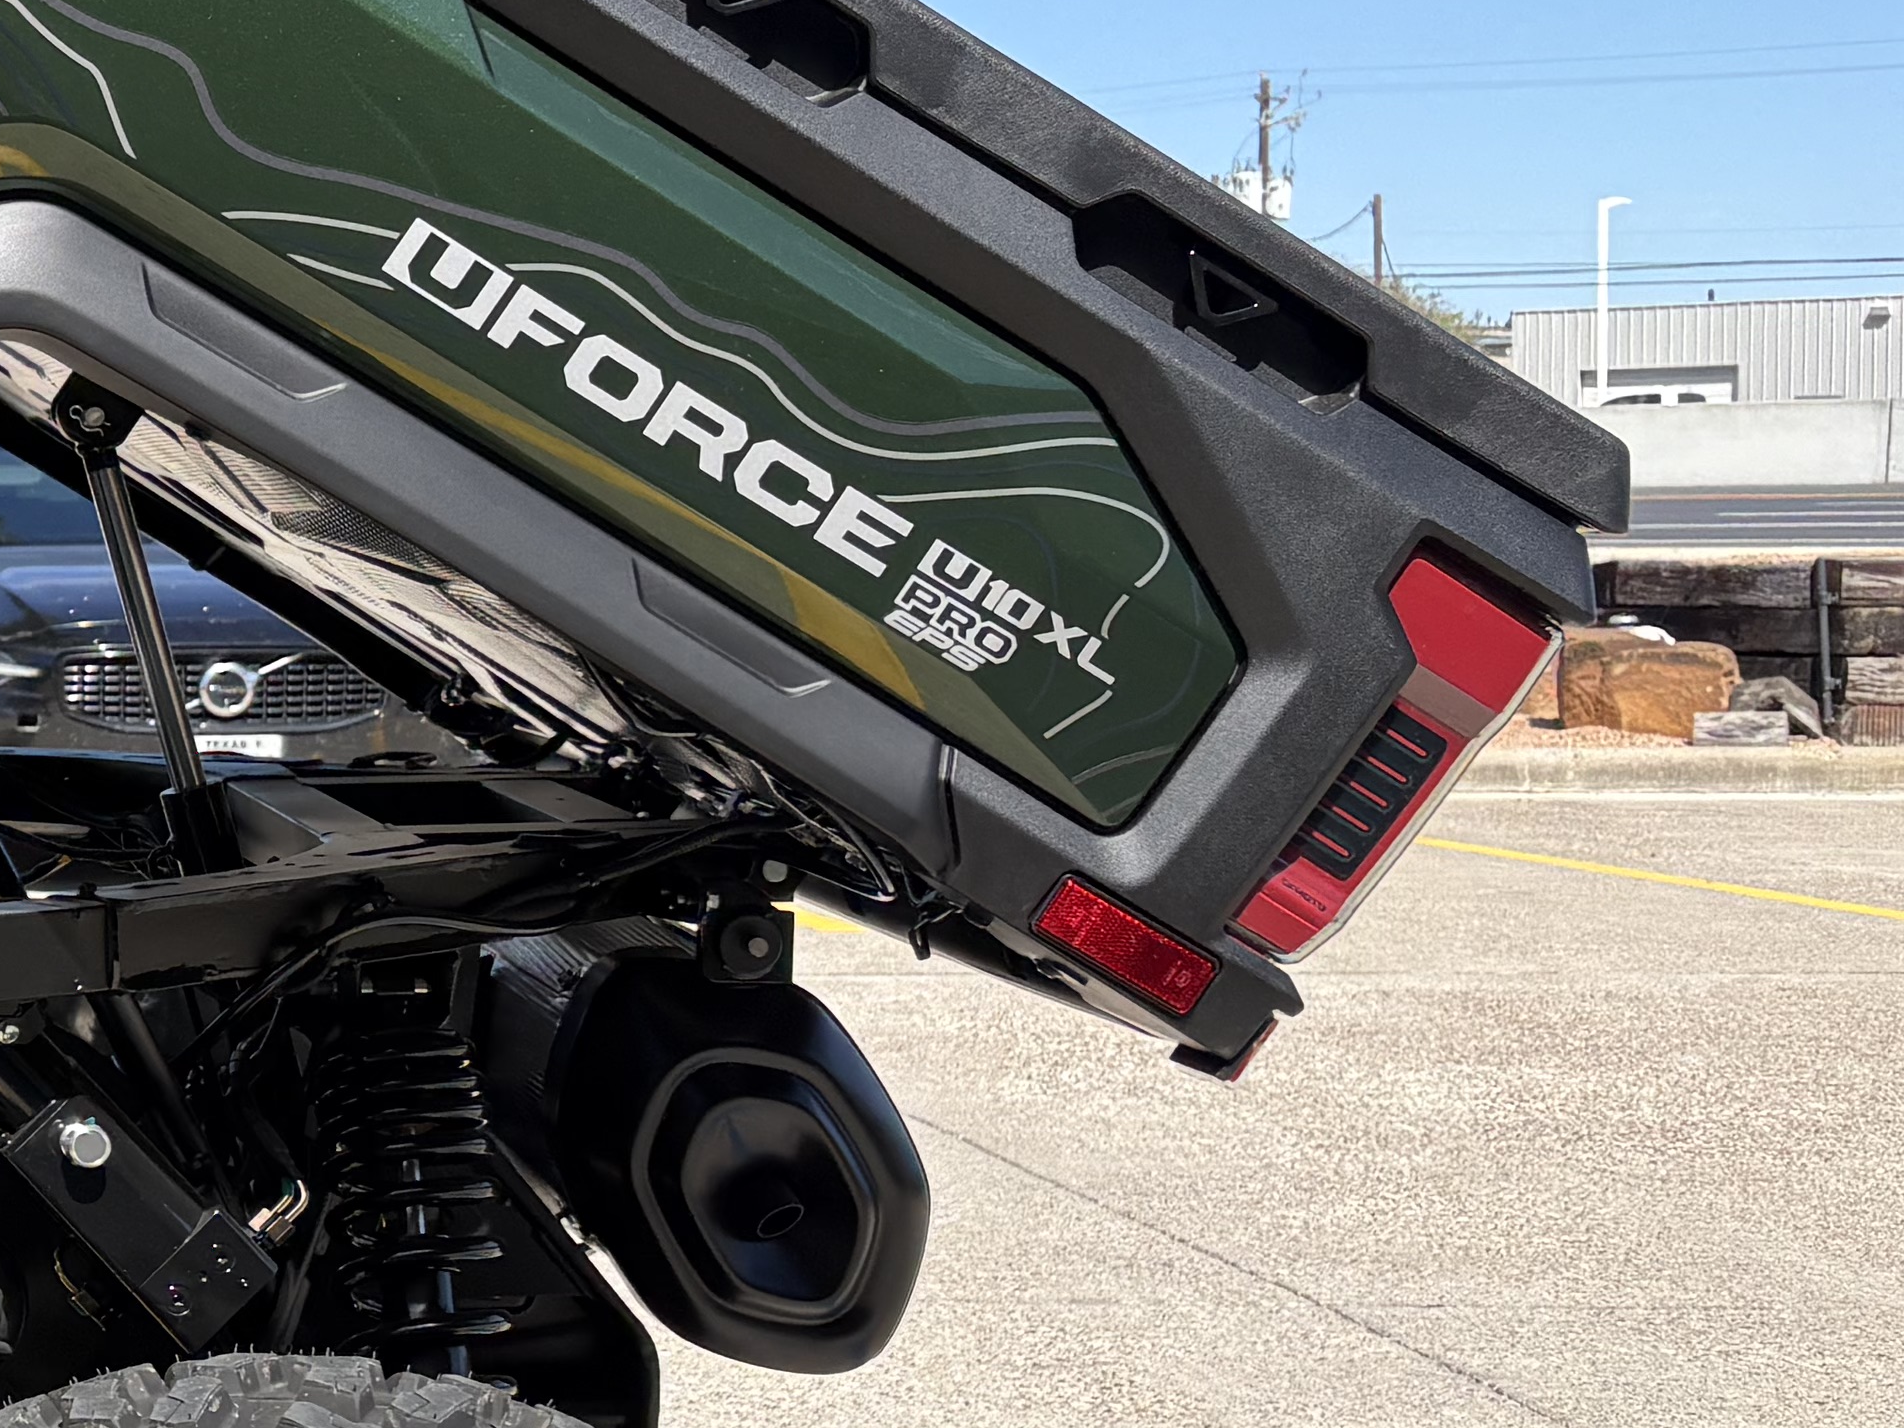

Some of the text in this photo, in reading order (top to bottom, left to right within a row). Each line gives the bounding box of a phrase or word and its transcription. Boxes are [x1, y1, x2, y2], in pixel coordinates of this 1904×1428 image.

[382, 217, 914, 578] UFORCE
[884, 609, 986, 672] EPS
[894, 574, 1018, 665] PRO
[917, 538, 1115, 685] U10 XL
